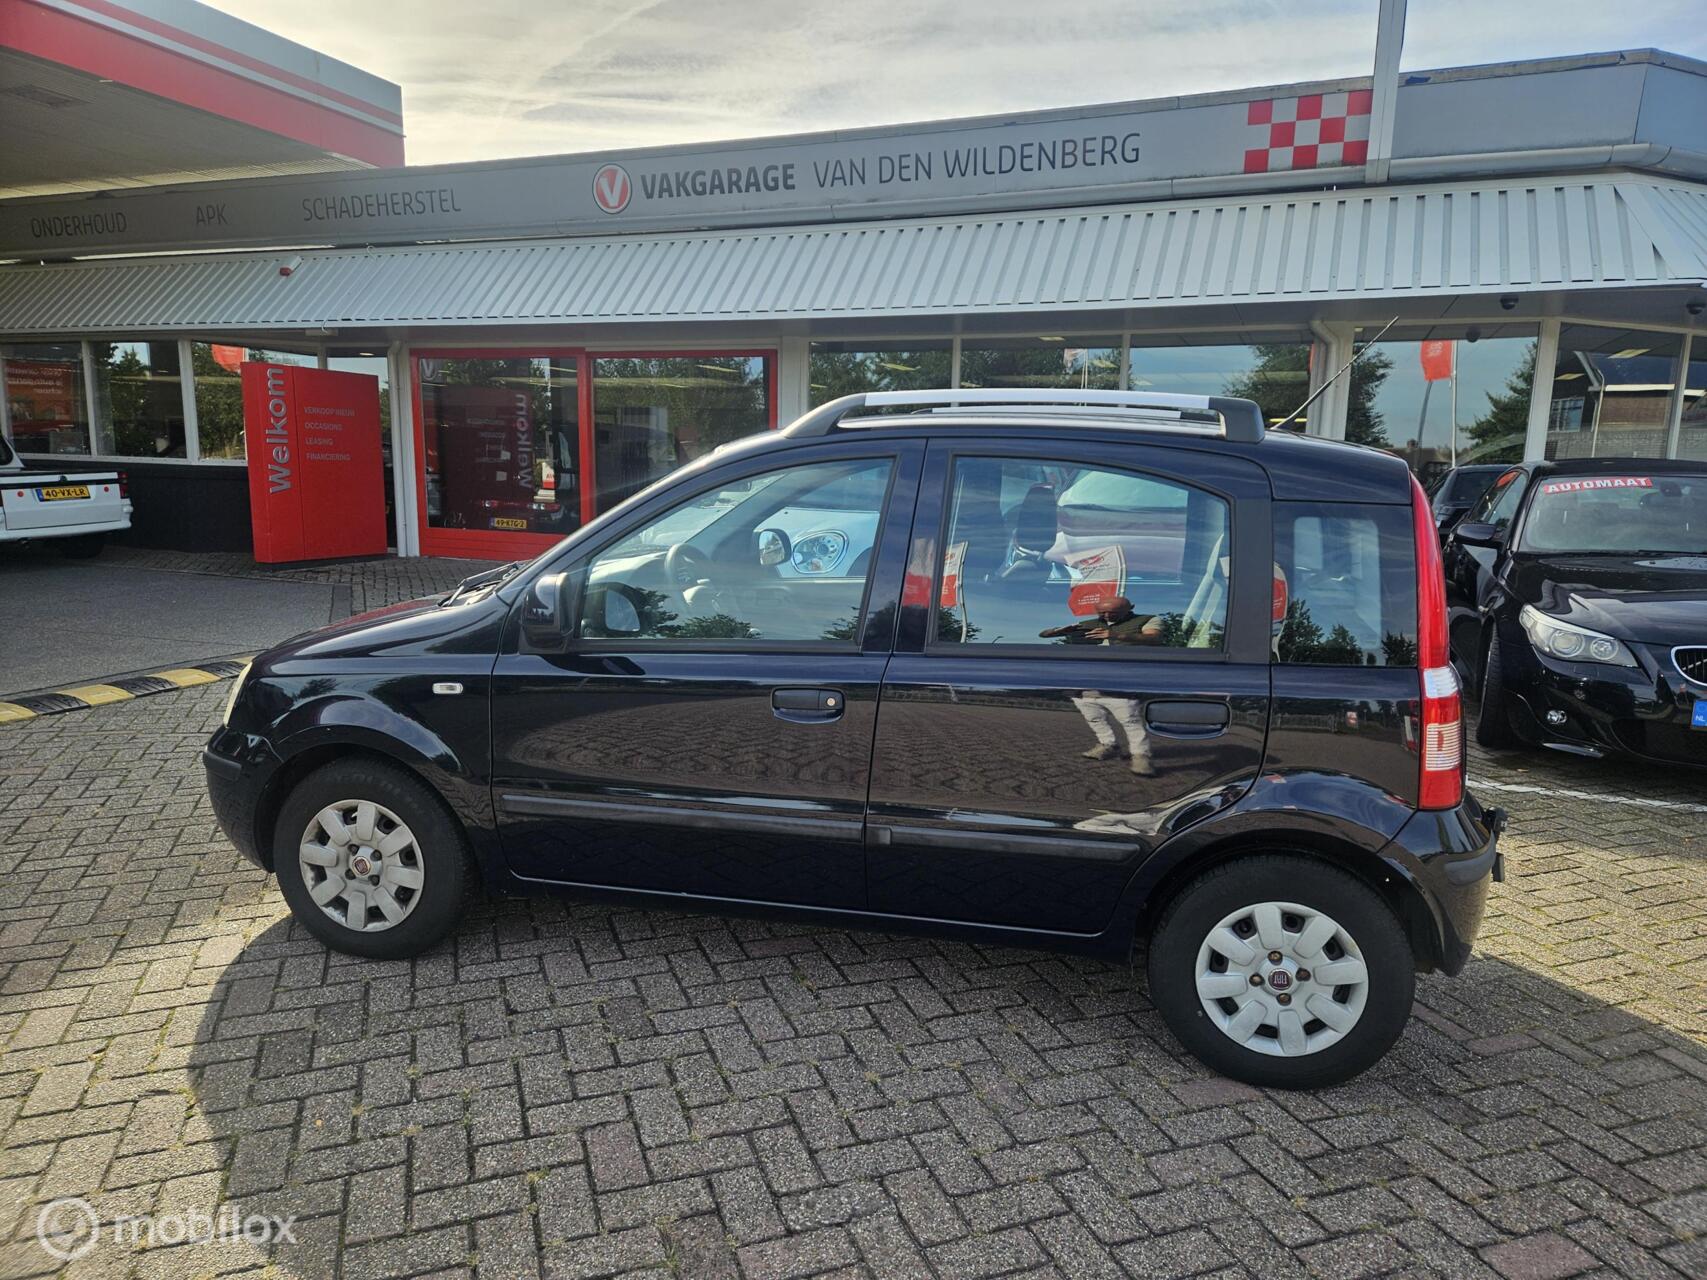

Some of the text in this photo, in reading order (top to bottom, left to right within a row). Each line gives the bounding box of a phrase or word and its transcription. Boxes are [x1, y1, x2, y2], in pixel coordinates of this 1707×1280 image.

[640, 132, 1141, 200] VAKGARAGE VAN DEN WILDENBERG
[302, 188, 462, 221] SCHADEHERSTEL
[195, 203, 229, 226] APK
[31, 211, 128, 238] ONDERHOUD
[265, 367, 292, 494] Welkom
[304, 422, 343, 432] OCCASIONS
[305, 437, 334, 446] LEASING
[306, 452, 352, 462] FINANCIERING
[44, 487, 87, 498] 40-VX-LR
[1548, 477, 1649, 493] AUTOMAAT
